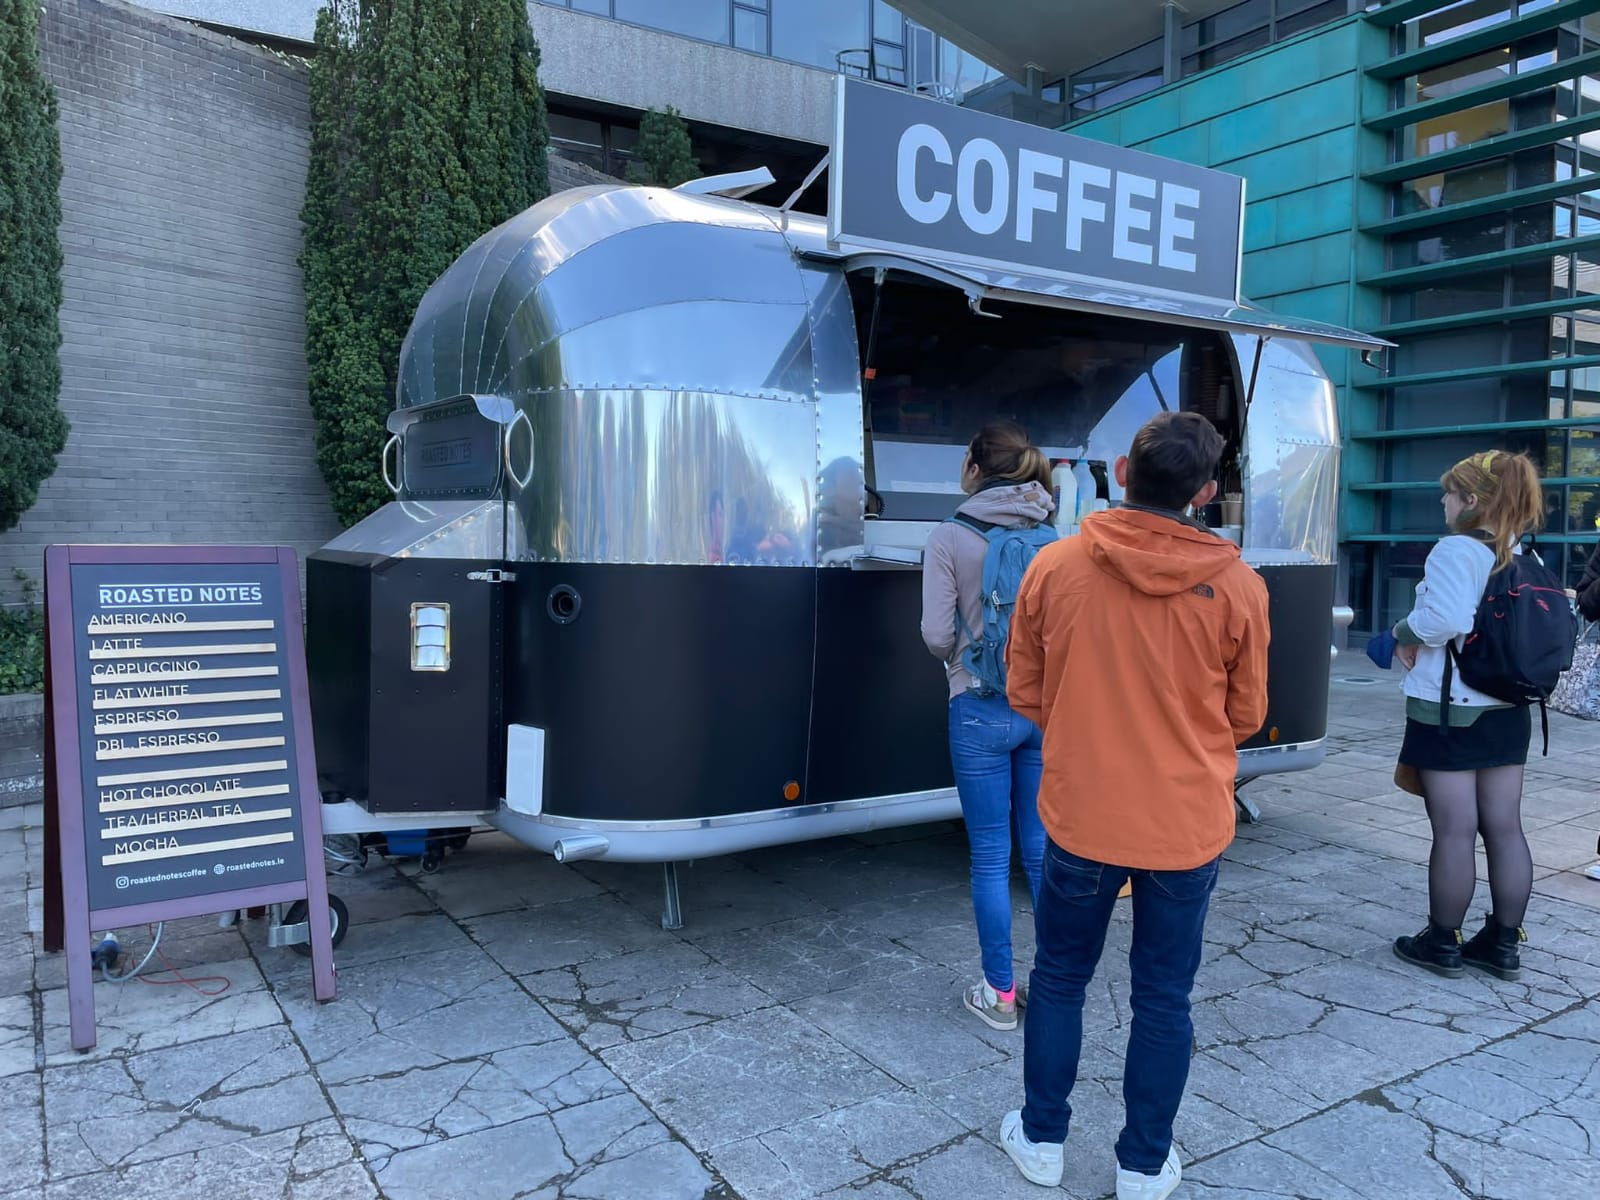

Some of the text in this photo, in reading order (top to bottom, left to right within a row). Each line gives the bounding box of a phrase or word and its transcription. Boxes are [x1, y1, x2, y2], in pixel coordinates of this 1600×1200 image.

[896, 123, 1200, 272] COFFEE
[99, 586, 262, 604] ROASTED NOTES
[89, 612, 187, 626] AMERICANO
[92, 638, 143, 651] LATTE
[93, 660, 201, 676] CAPPUCCINO
[94, 684, 189, 701] FLAT WHITE
[95, 709, 180, 726] ESPRESSO
[138, 732, 220, 748] ESPRESSO
[101, 778, 241, 803] HOT CHOCOLATE
[105, 804, 244, 830] TEA/HERBAL TEA
[114, 836, 180, 855] MOCHA
[226, 857, 285, 873] roastednotes.ie
[130, 868, 207, 886] roastednotescoffee
